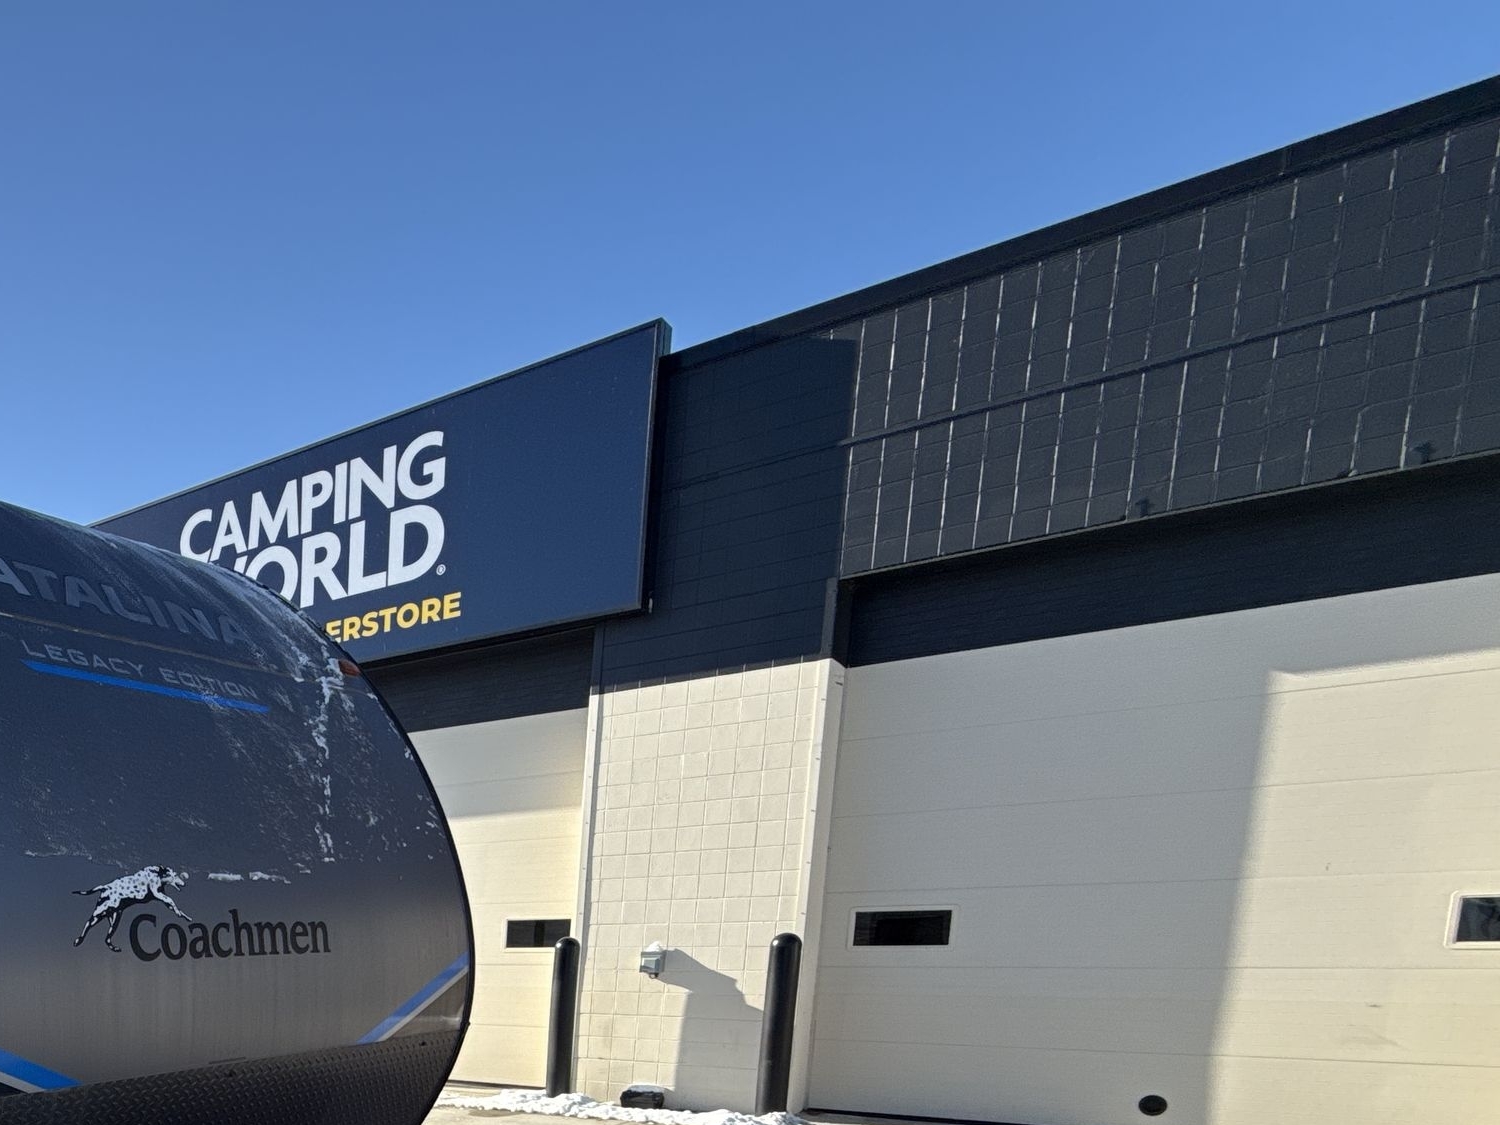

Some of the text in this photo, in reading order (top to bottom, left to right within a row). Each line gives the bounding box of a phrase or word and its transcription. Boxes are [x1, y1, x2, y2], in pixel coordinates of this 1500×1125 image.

[180, 431, 446, 563] CAMPING
[233, 504, 445, 608] ORLD
[325, 592, 461, 643] ERSTORE
[21, 640, 258, 699] LEGACY EDITION
[129, 908, 331, 962] Coachmen
